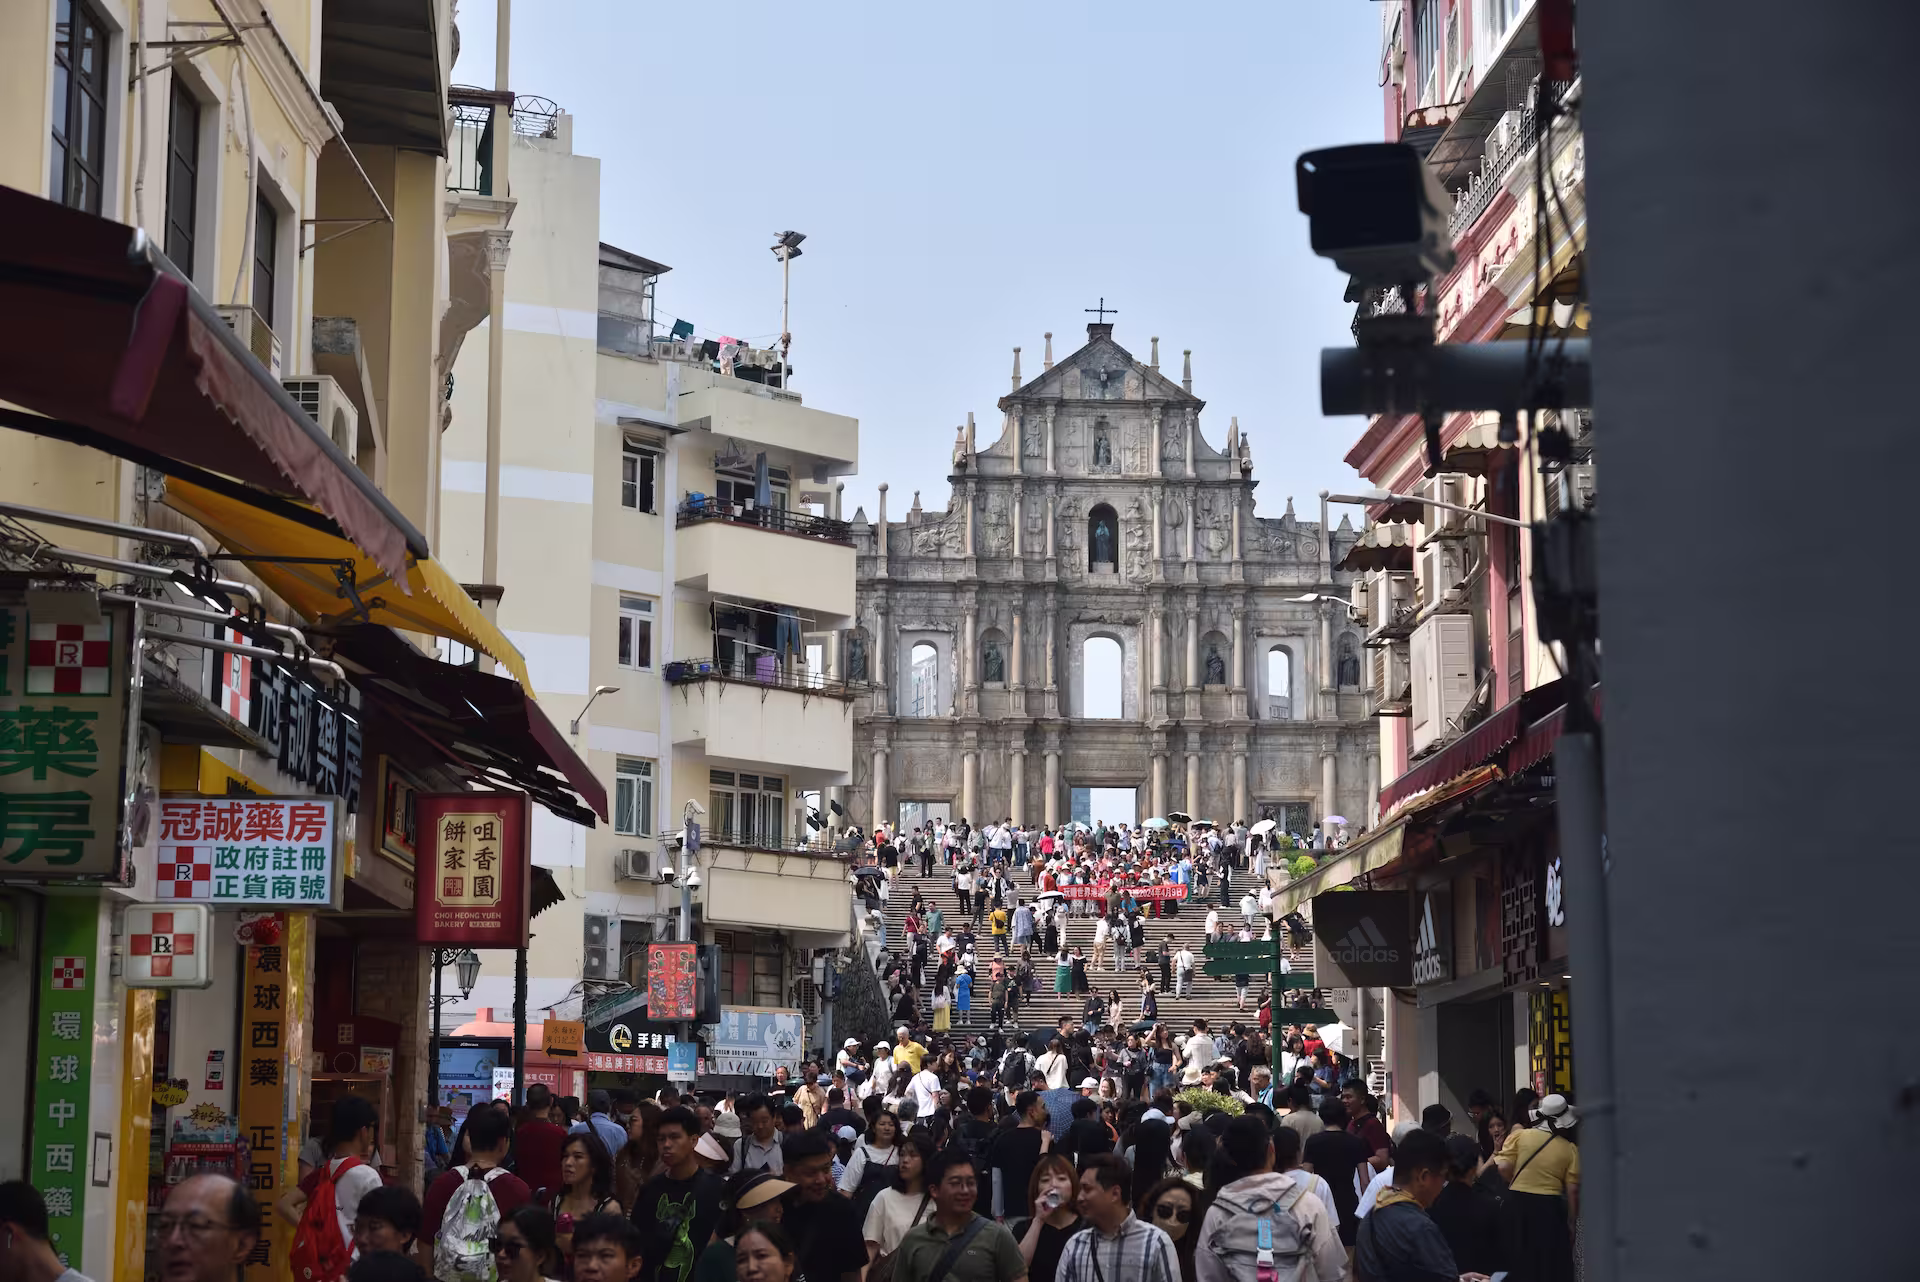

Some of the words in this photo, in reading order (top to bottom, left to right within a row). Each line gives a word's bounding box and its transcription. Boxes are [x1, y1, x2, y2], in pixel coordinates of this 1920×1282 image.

[160, 801, 327, 843] 冠誠藥房
[214, 845, 326, 871] 政府註冊
[443, 820, 467, 871] 餅家
[472, 821, 497, 899] 咀香園
[213, 874, 325, 899] 正貨商號
[1328, 945, 1399, 964] adidas
[1413, 947, 1441, 985] adidas
[249, 946, 281, 1086] 環球西藥
[538, 1073, 555, 1081] CTT
